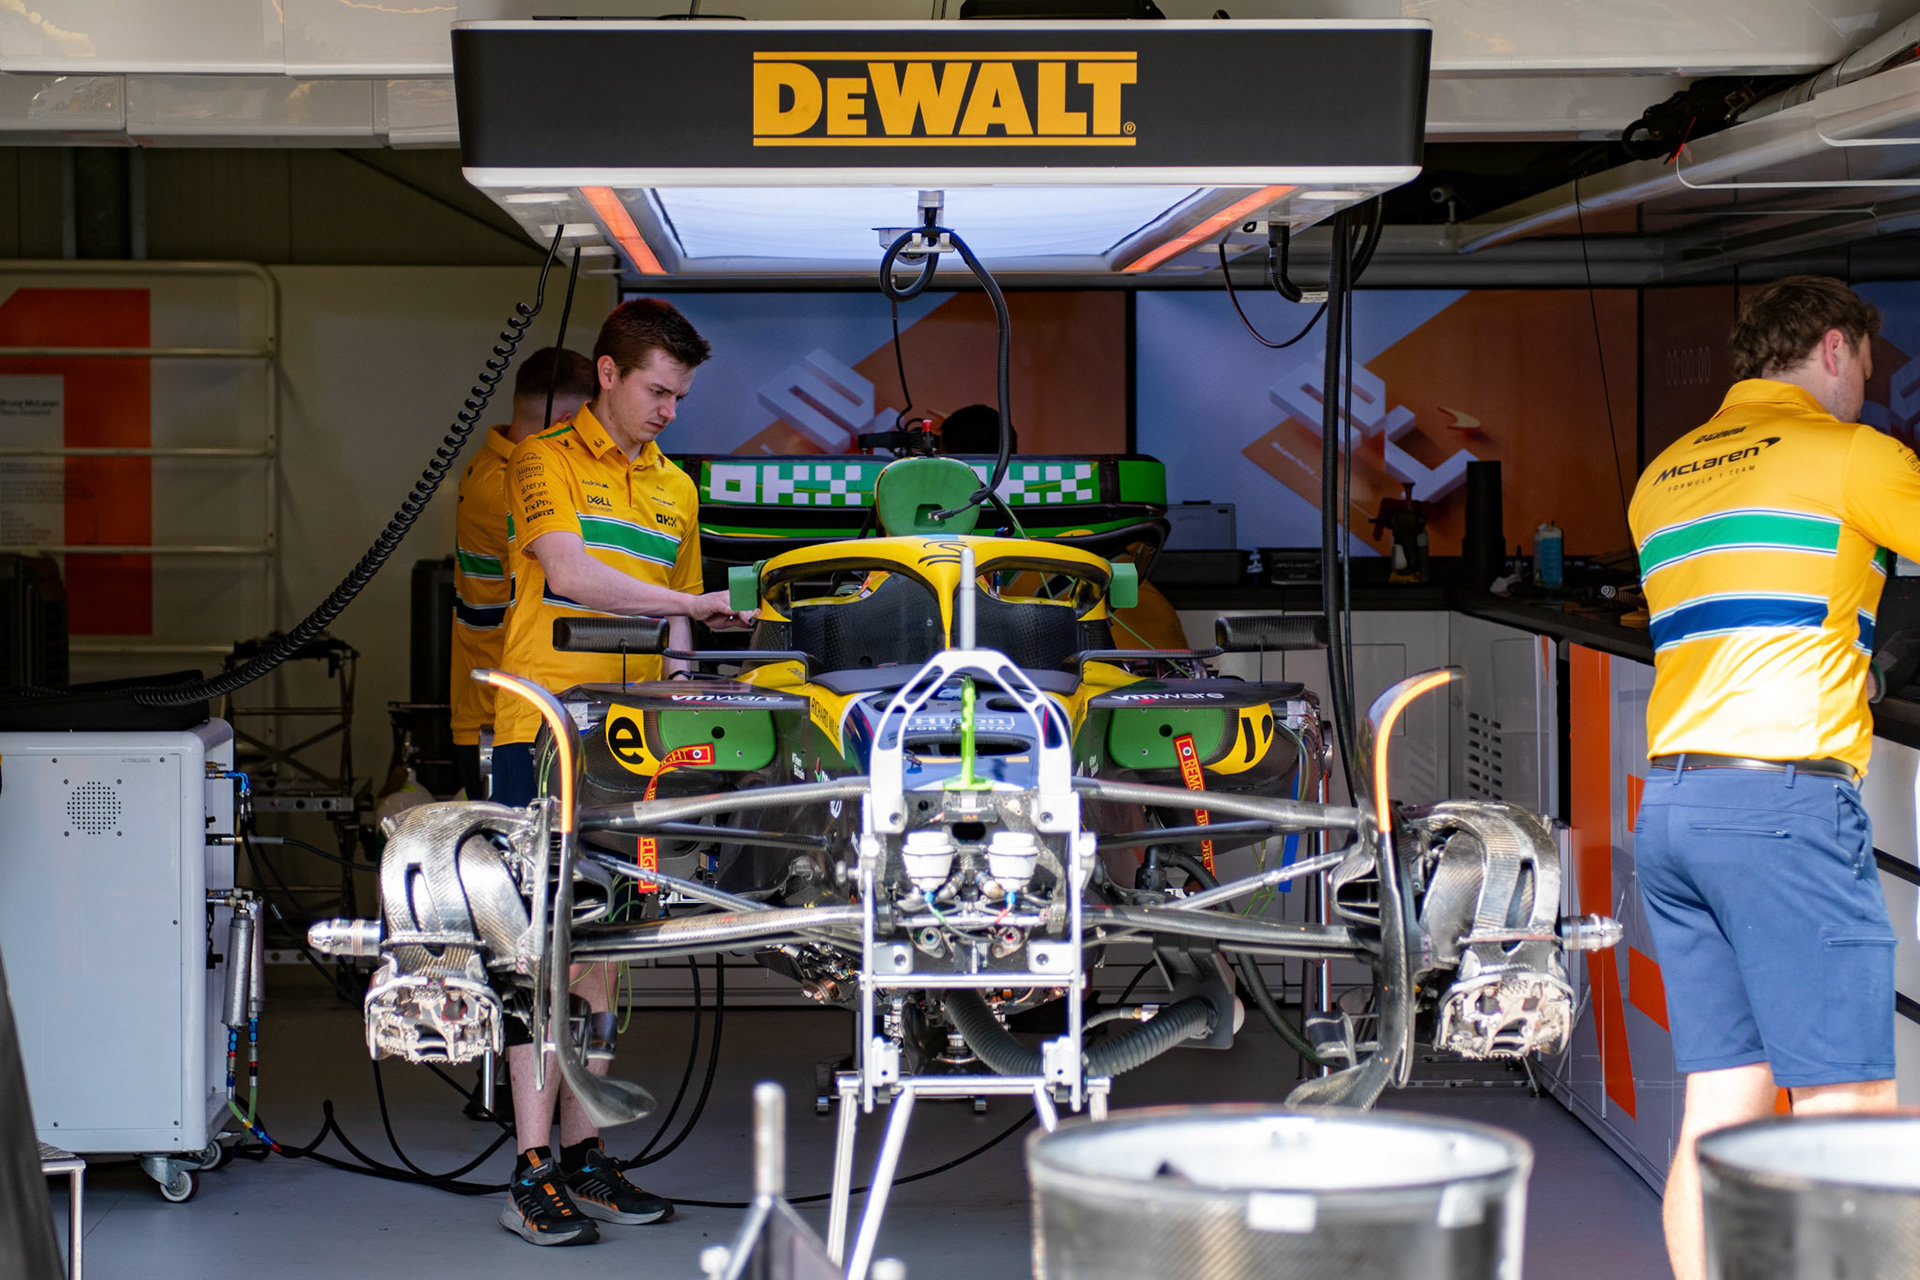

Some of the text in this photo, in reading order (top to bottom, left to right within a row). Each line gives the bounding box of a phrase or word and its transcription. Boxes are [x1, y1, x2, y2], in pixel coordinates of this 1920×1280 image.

[1653, 446, 1760, 487] McLaren
[1667, 477, 1713, 492] FORMULA
[1730, 465, 1756, 476] TEAM
[709, 464, 862, 506] OKX
[975, 464, 1093, 505] KX
[586, 495, 613, 507] DELL
[1110, 692, 1225, 701] vmware
[811, 697, 829, 728] RICHARD
